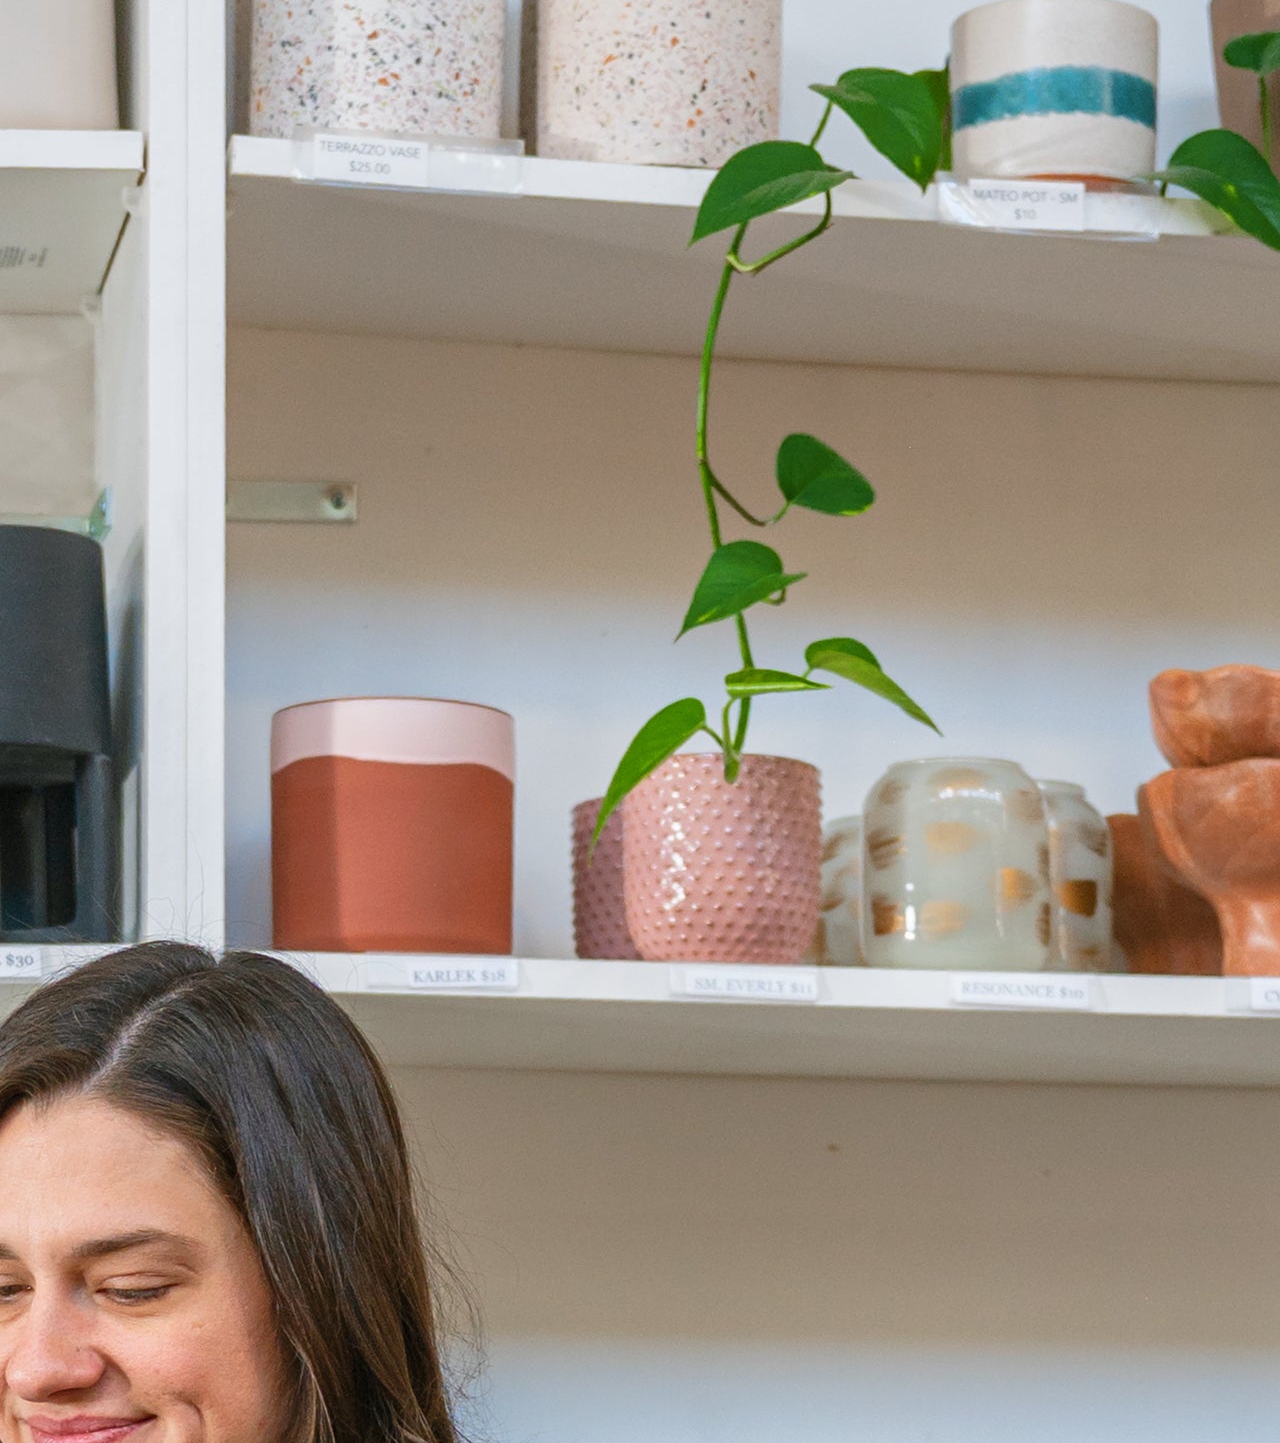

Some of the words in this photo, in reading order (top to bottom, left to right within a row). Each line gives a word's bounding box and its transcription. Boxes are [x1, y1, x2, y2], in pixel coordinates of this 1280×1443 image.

[320, 140, 386, 157] TERRAZZO
[389, 146, 421, 159] VASE
[1022, 190, 1047, 202] POT
[6, 954, 34, 968] $30
[413, 970, 477, 983] KARLEK
[481, 970, 507, 982] $18
[725, 979, 786, 993] EVERLY
[962, 982, 1056, 997] RESONANCE
